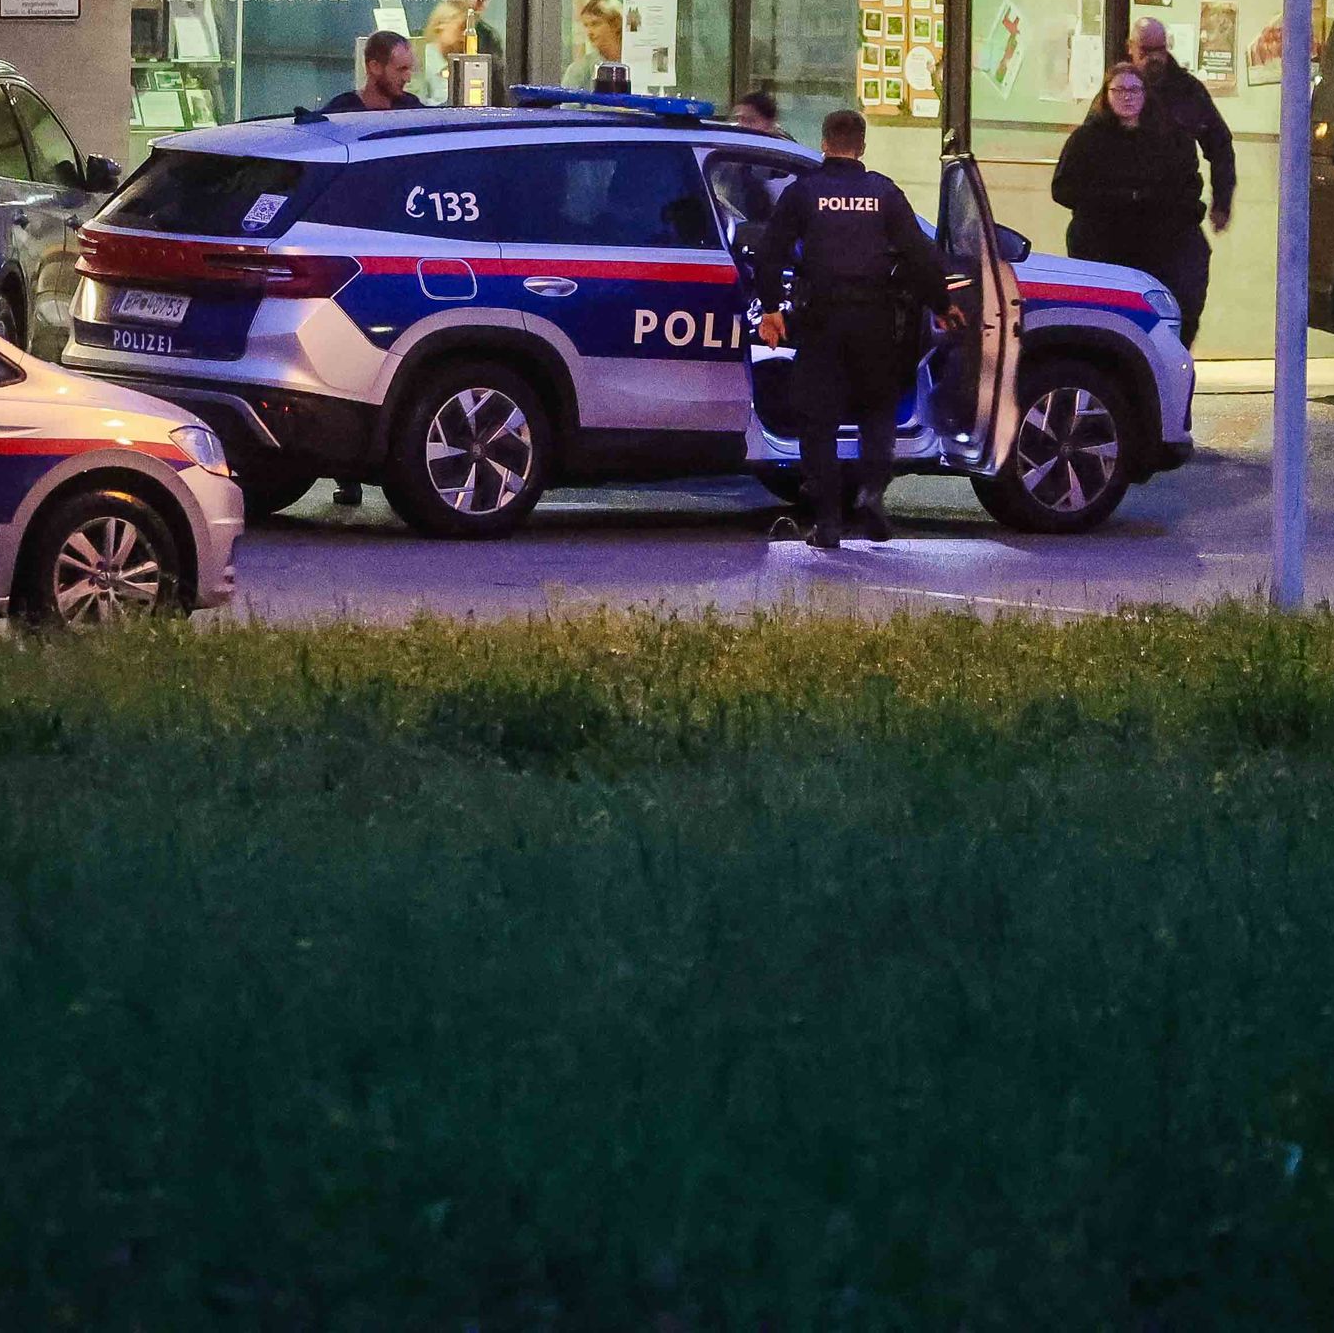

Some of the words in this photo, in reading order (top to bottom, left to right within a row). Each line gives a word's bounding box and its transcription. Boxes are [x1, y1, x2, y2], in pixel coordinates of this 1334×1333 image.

[428, 192, 479, 221] 133
[818, 197, 879, 211] POLIZEI
[113, 329, 172, 353] POLIZEI
